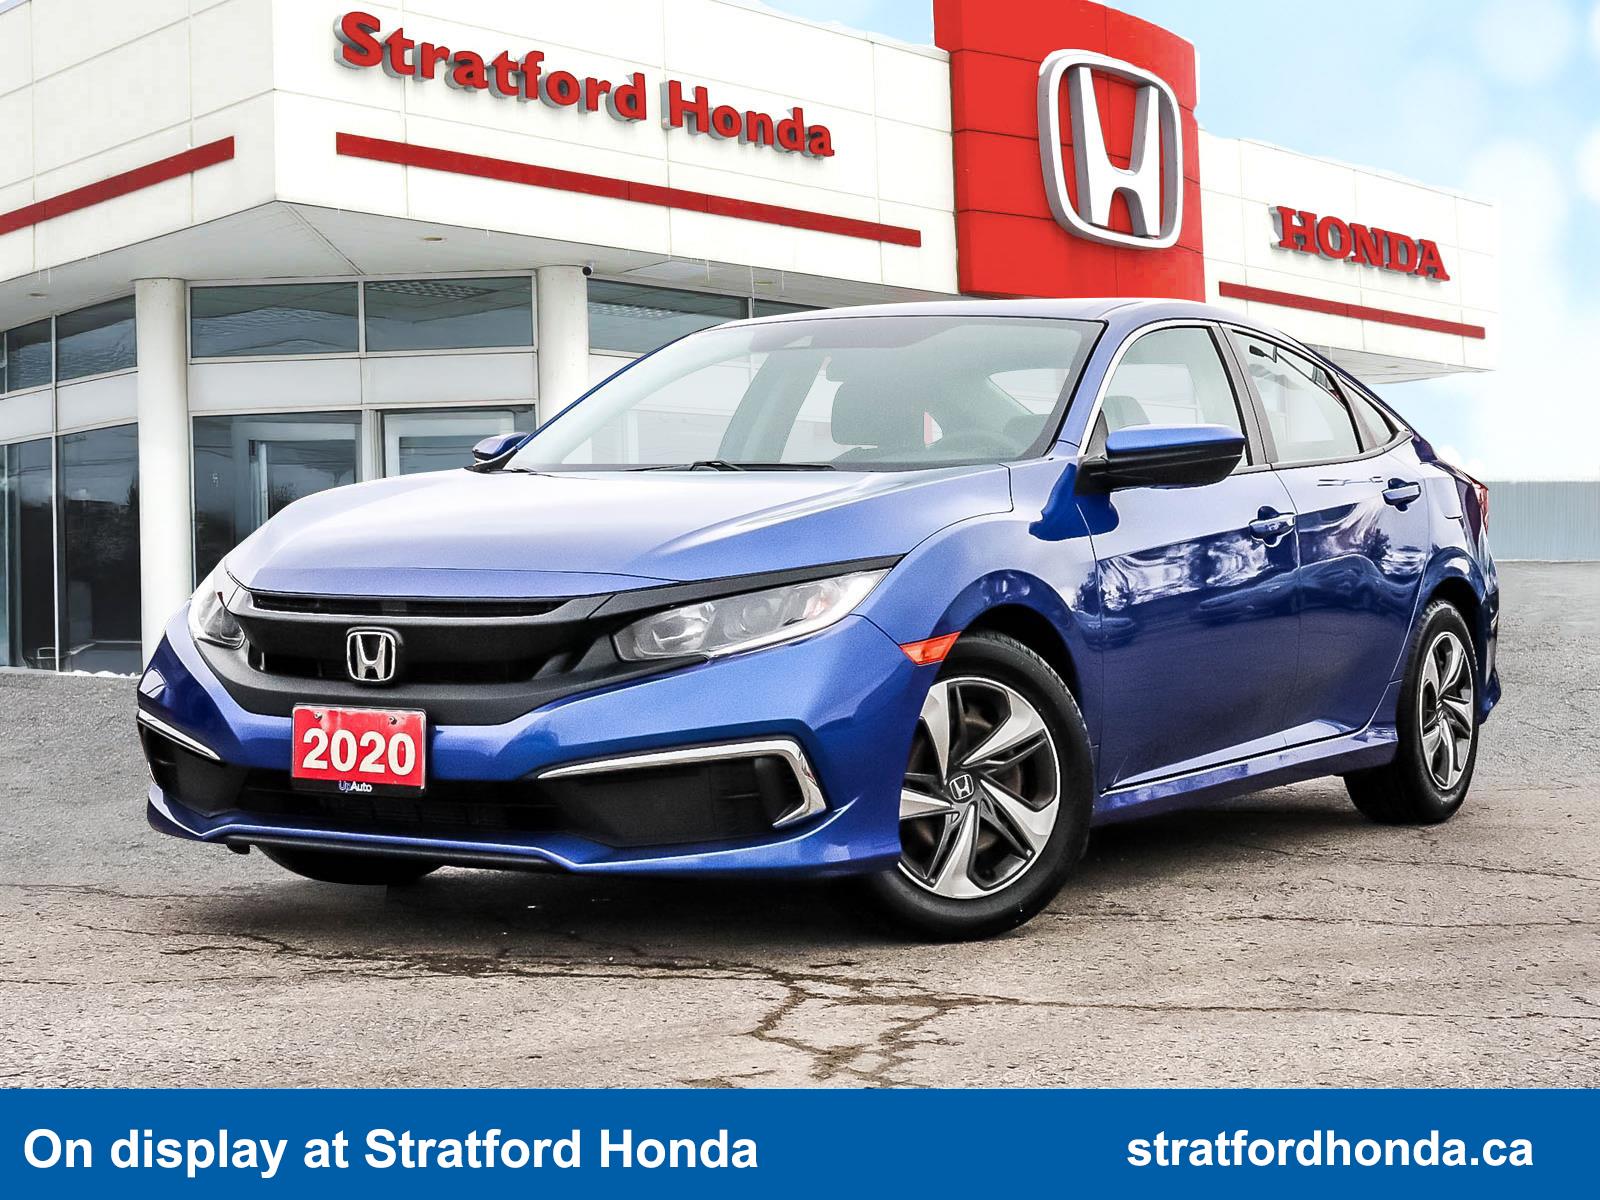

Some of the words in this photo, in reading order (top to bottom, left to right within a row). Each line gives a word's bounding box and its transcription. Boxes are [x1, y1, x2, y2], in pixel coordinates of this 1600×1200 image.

[337, 11, 647, 121] Stratford
[663, 80, 835, 157] Honda
[1272, 206, 1450, 282] HONDA
[302, 728, 416, 776] 2020
